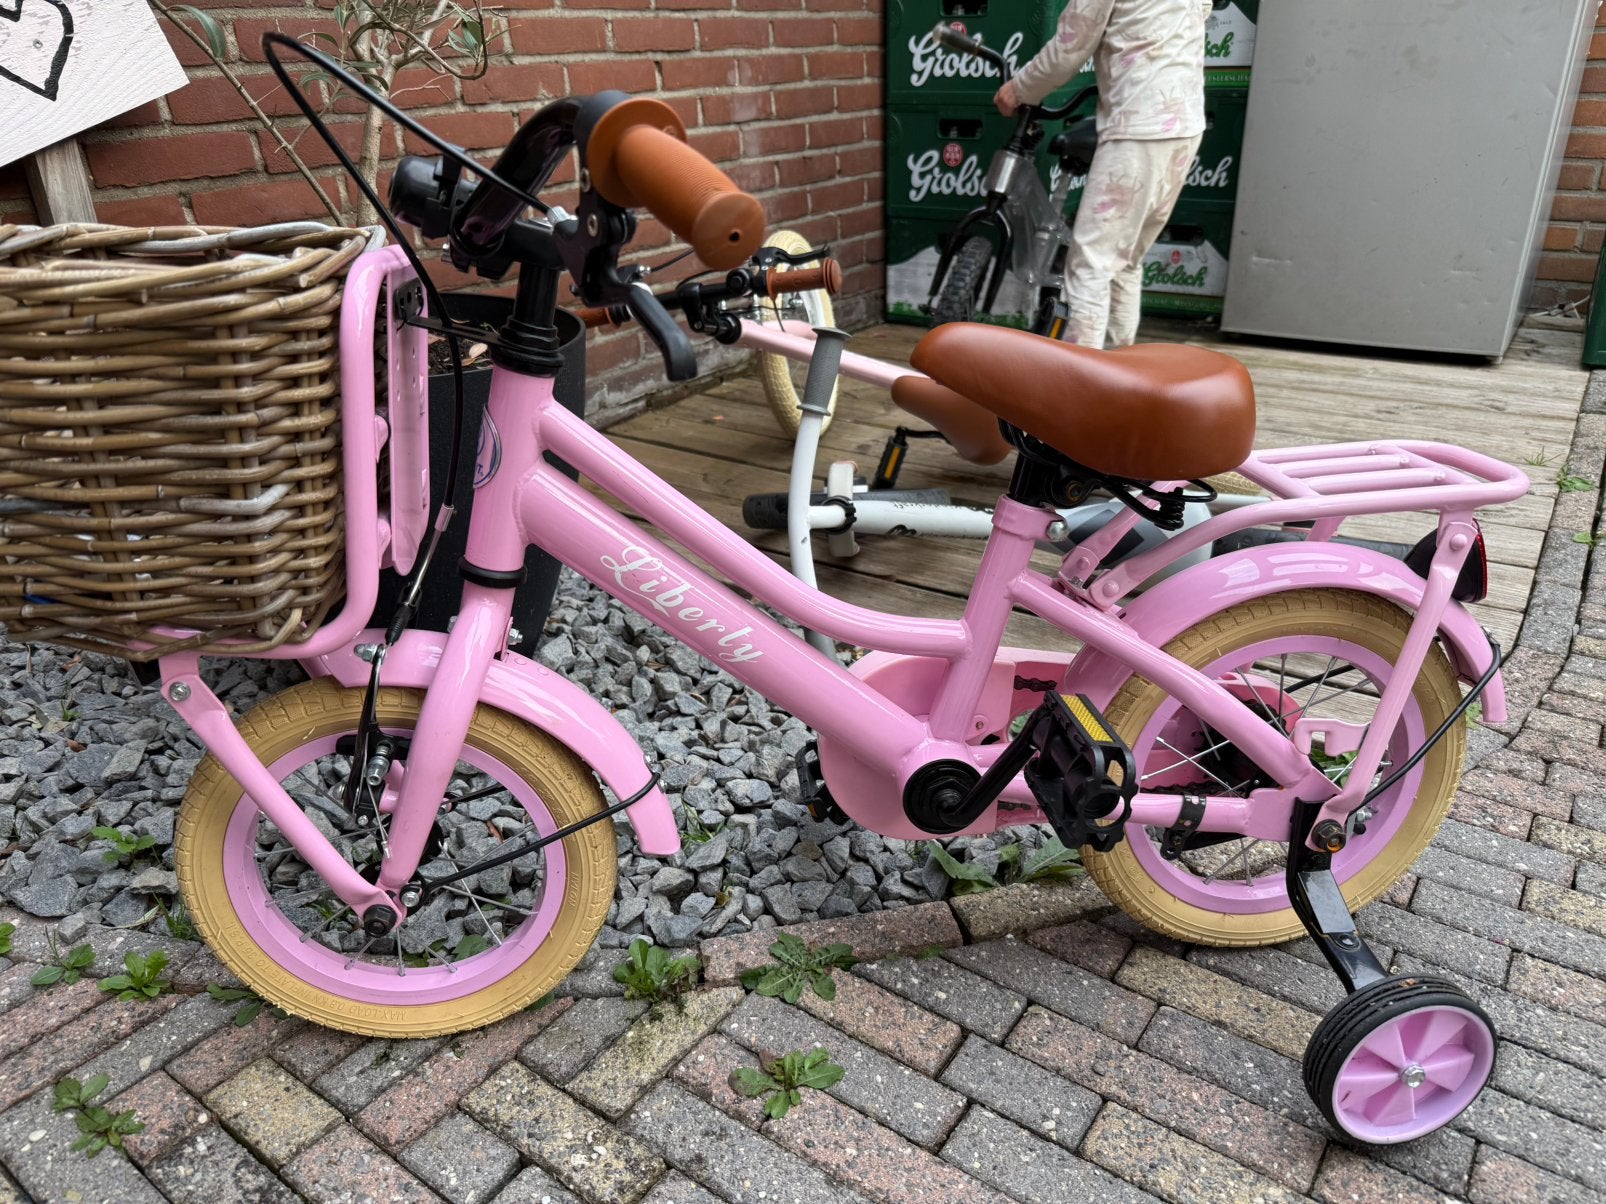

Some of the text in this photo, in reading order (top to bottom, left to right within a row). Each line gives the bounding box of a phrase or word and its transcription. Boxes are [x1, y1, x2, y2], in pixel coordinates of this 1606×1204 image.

[1142, 260, 1208, 288] Grolsch
[600, 545, 764, 663] Liberty
[255, 959, 270, 973] TO
